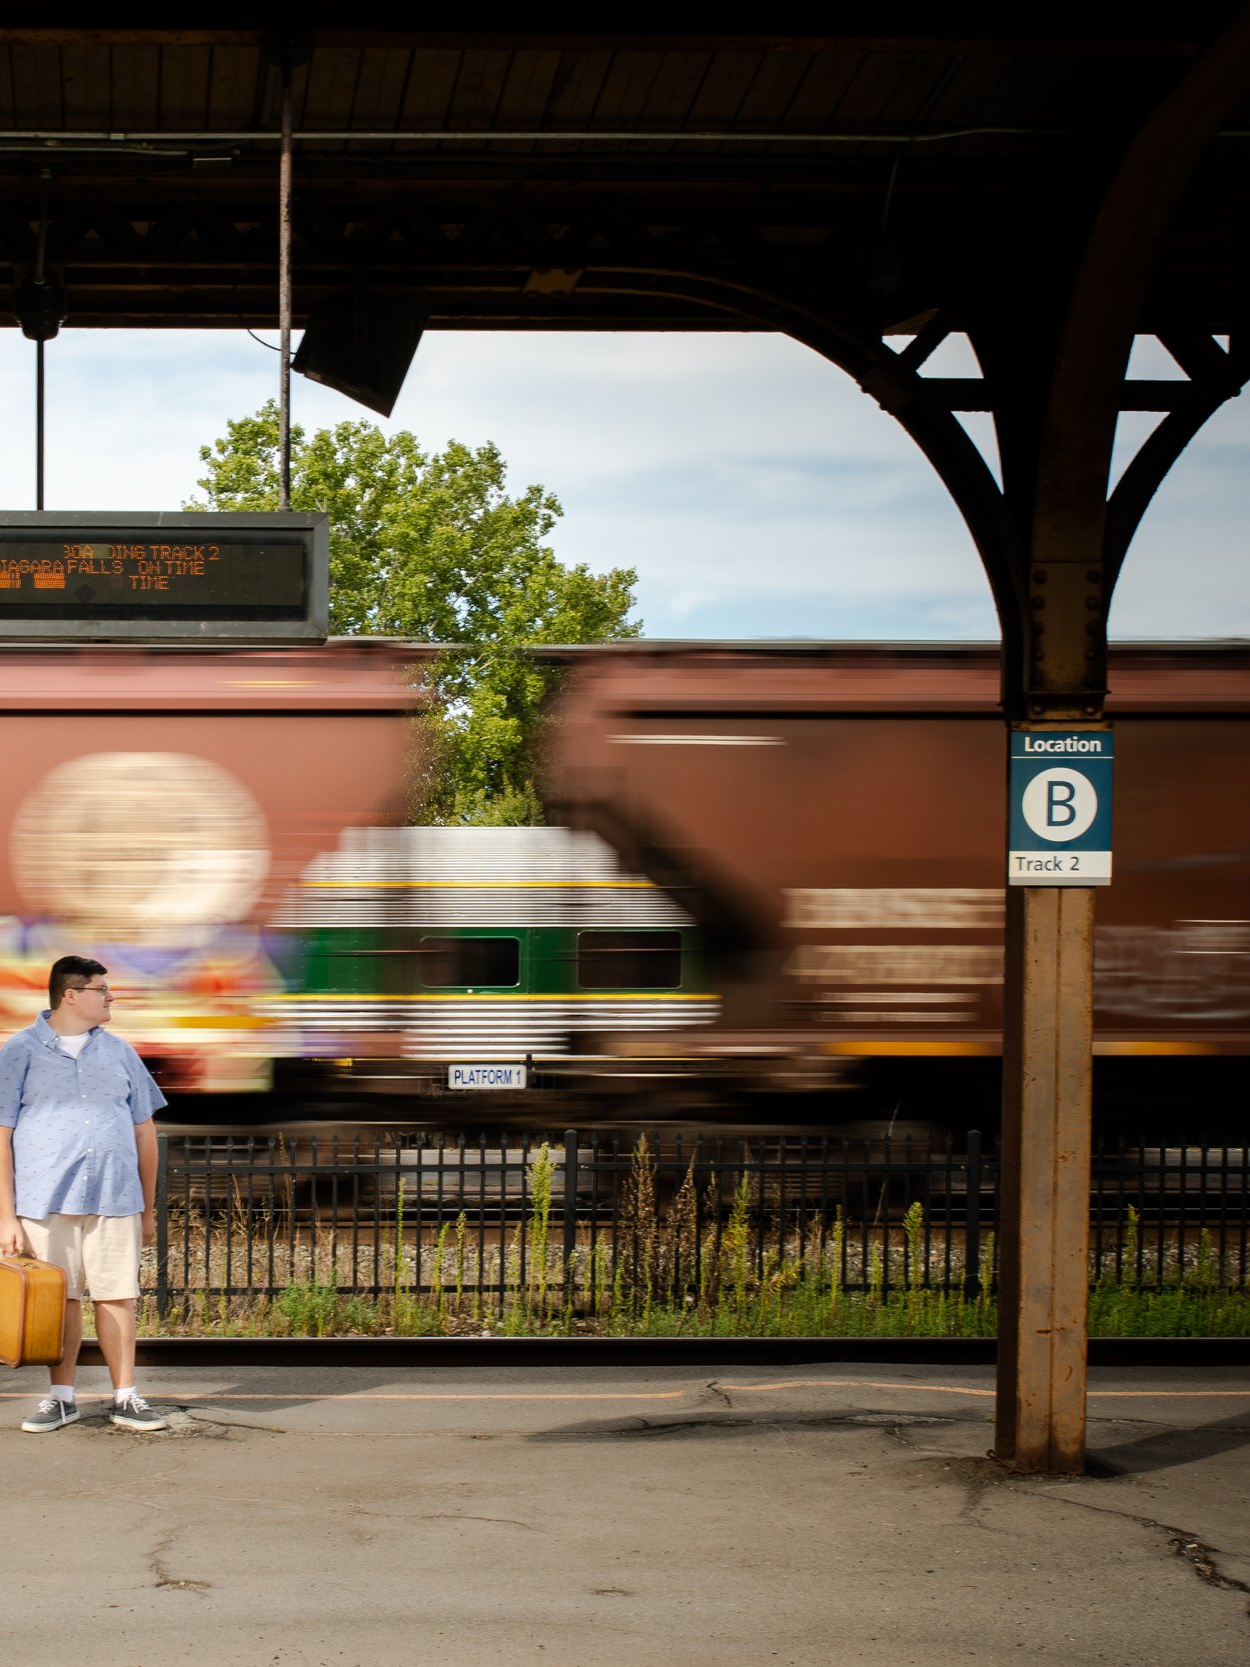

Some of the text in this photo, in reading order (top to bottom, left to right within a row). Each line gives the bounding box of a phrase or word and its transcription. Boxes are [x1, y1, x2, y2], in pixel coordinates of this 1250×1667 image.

[150, 545, 205, 560] TRACK
[208, 546, 221, 561] 2
[67, 560, 125, 575] FALLS
[138, 561, 160, 575] ON
[164, 561, 205, 575] TIME
[129, 575, 170, 590] TIME
[1024, 736, 1102, 752] Location
[1046, 780, 1077, 827] B
[1015, 856, 1080, 872] Track 2
[454, 1069, 522, 1085] PLATFORM 1
